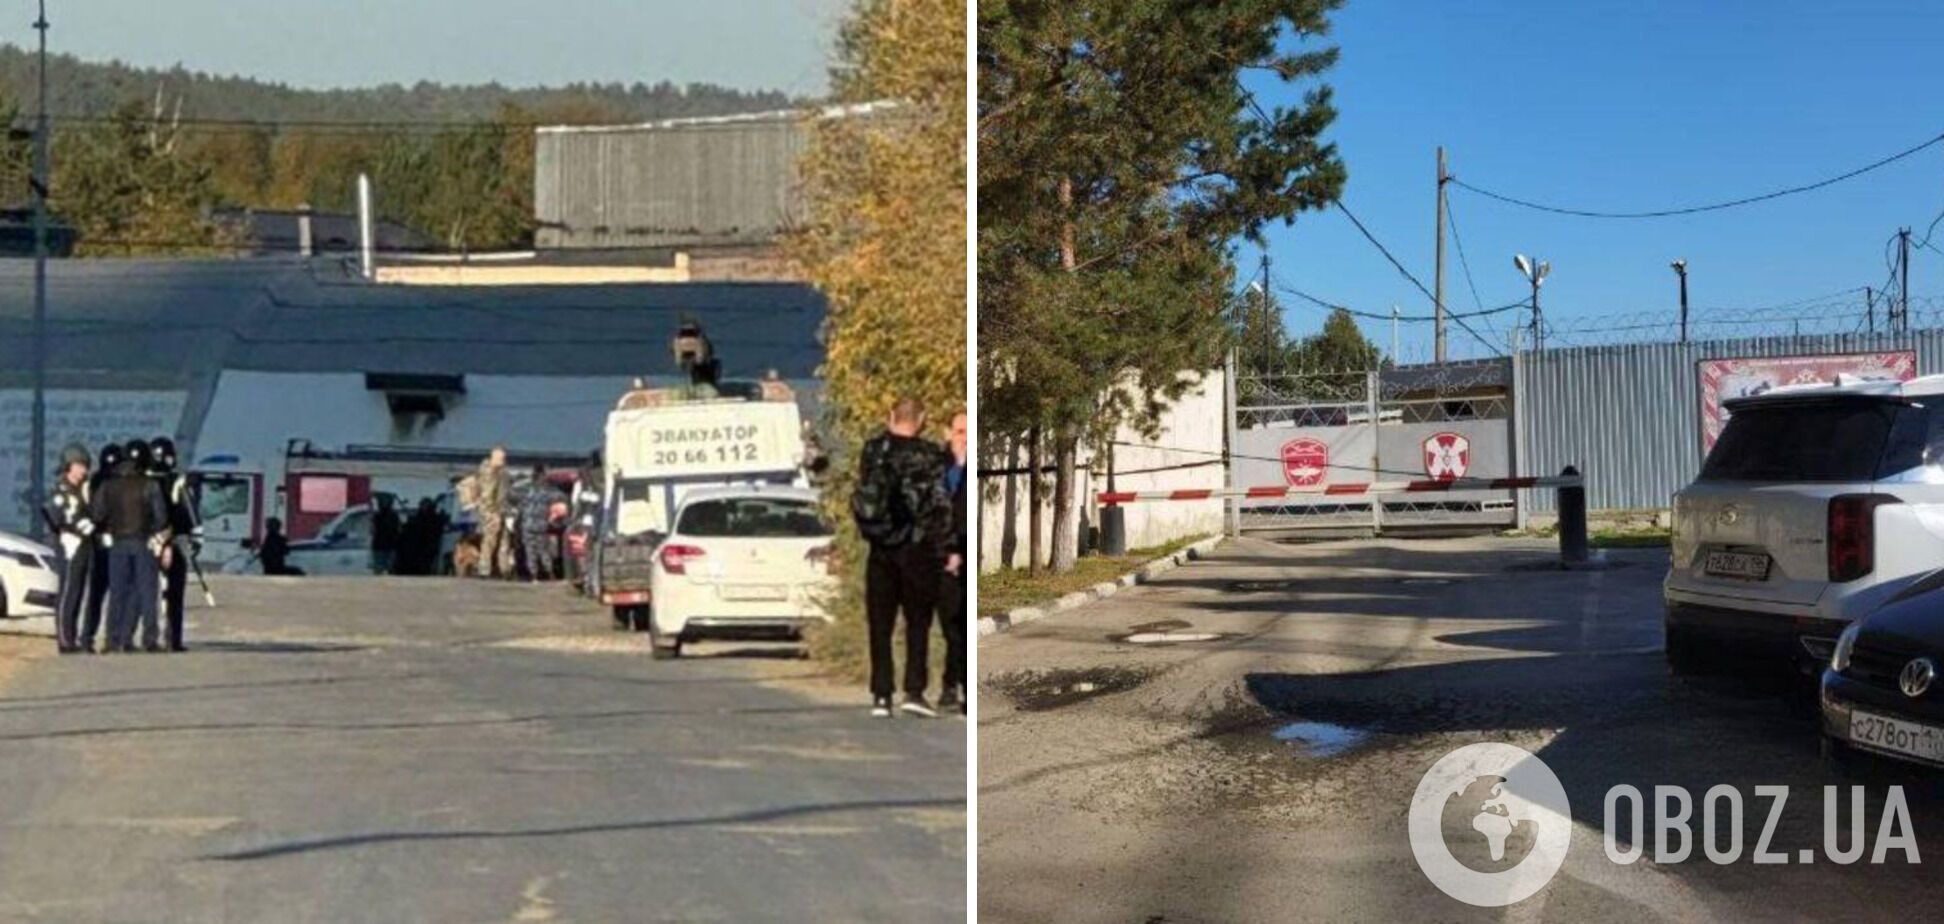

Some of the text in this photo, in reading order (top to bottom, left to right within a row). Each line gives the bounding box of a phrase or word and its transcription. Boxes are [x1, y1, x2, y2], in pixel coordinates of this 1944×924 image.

[652, 425, 758, 444] ЭВАКУАТОР
[655, 443, 757, 465] 20 66 112
[222, 517, 231, 532] 1
